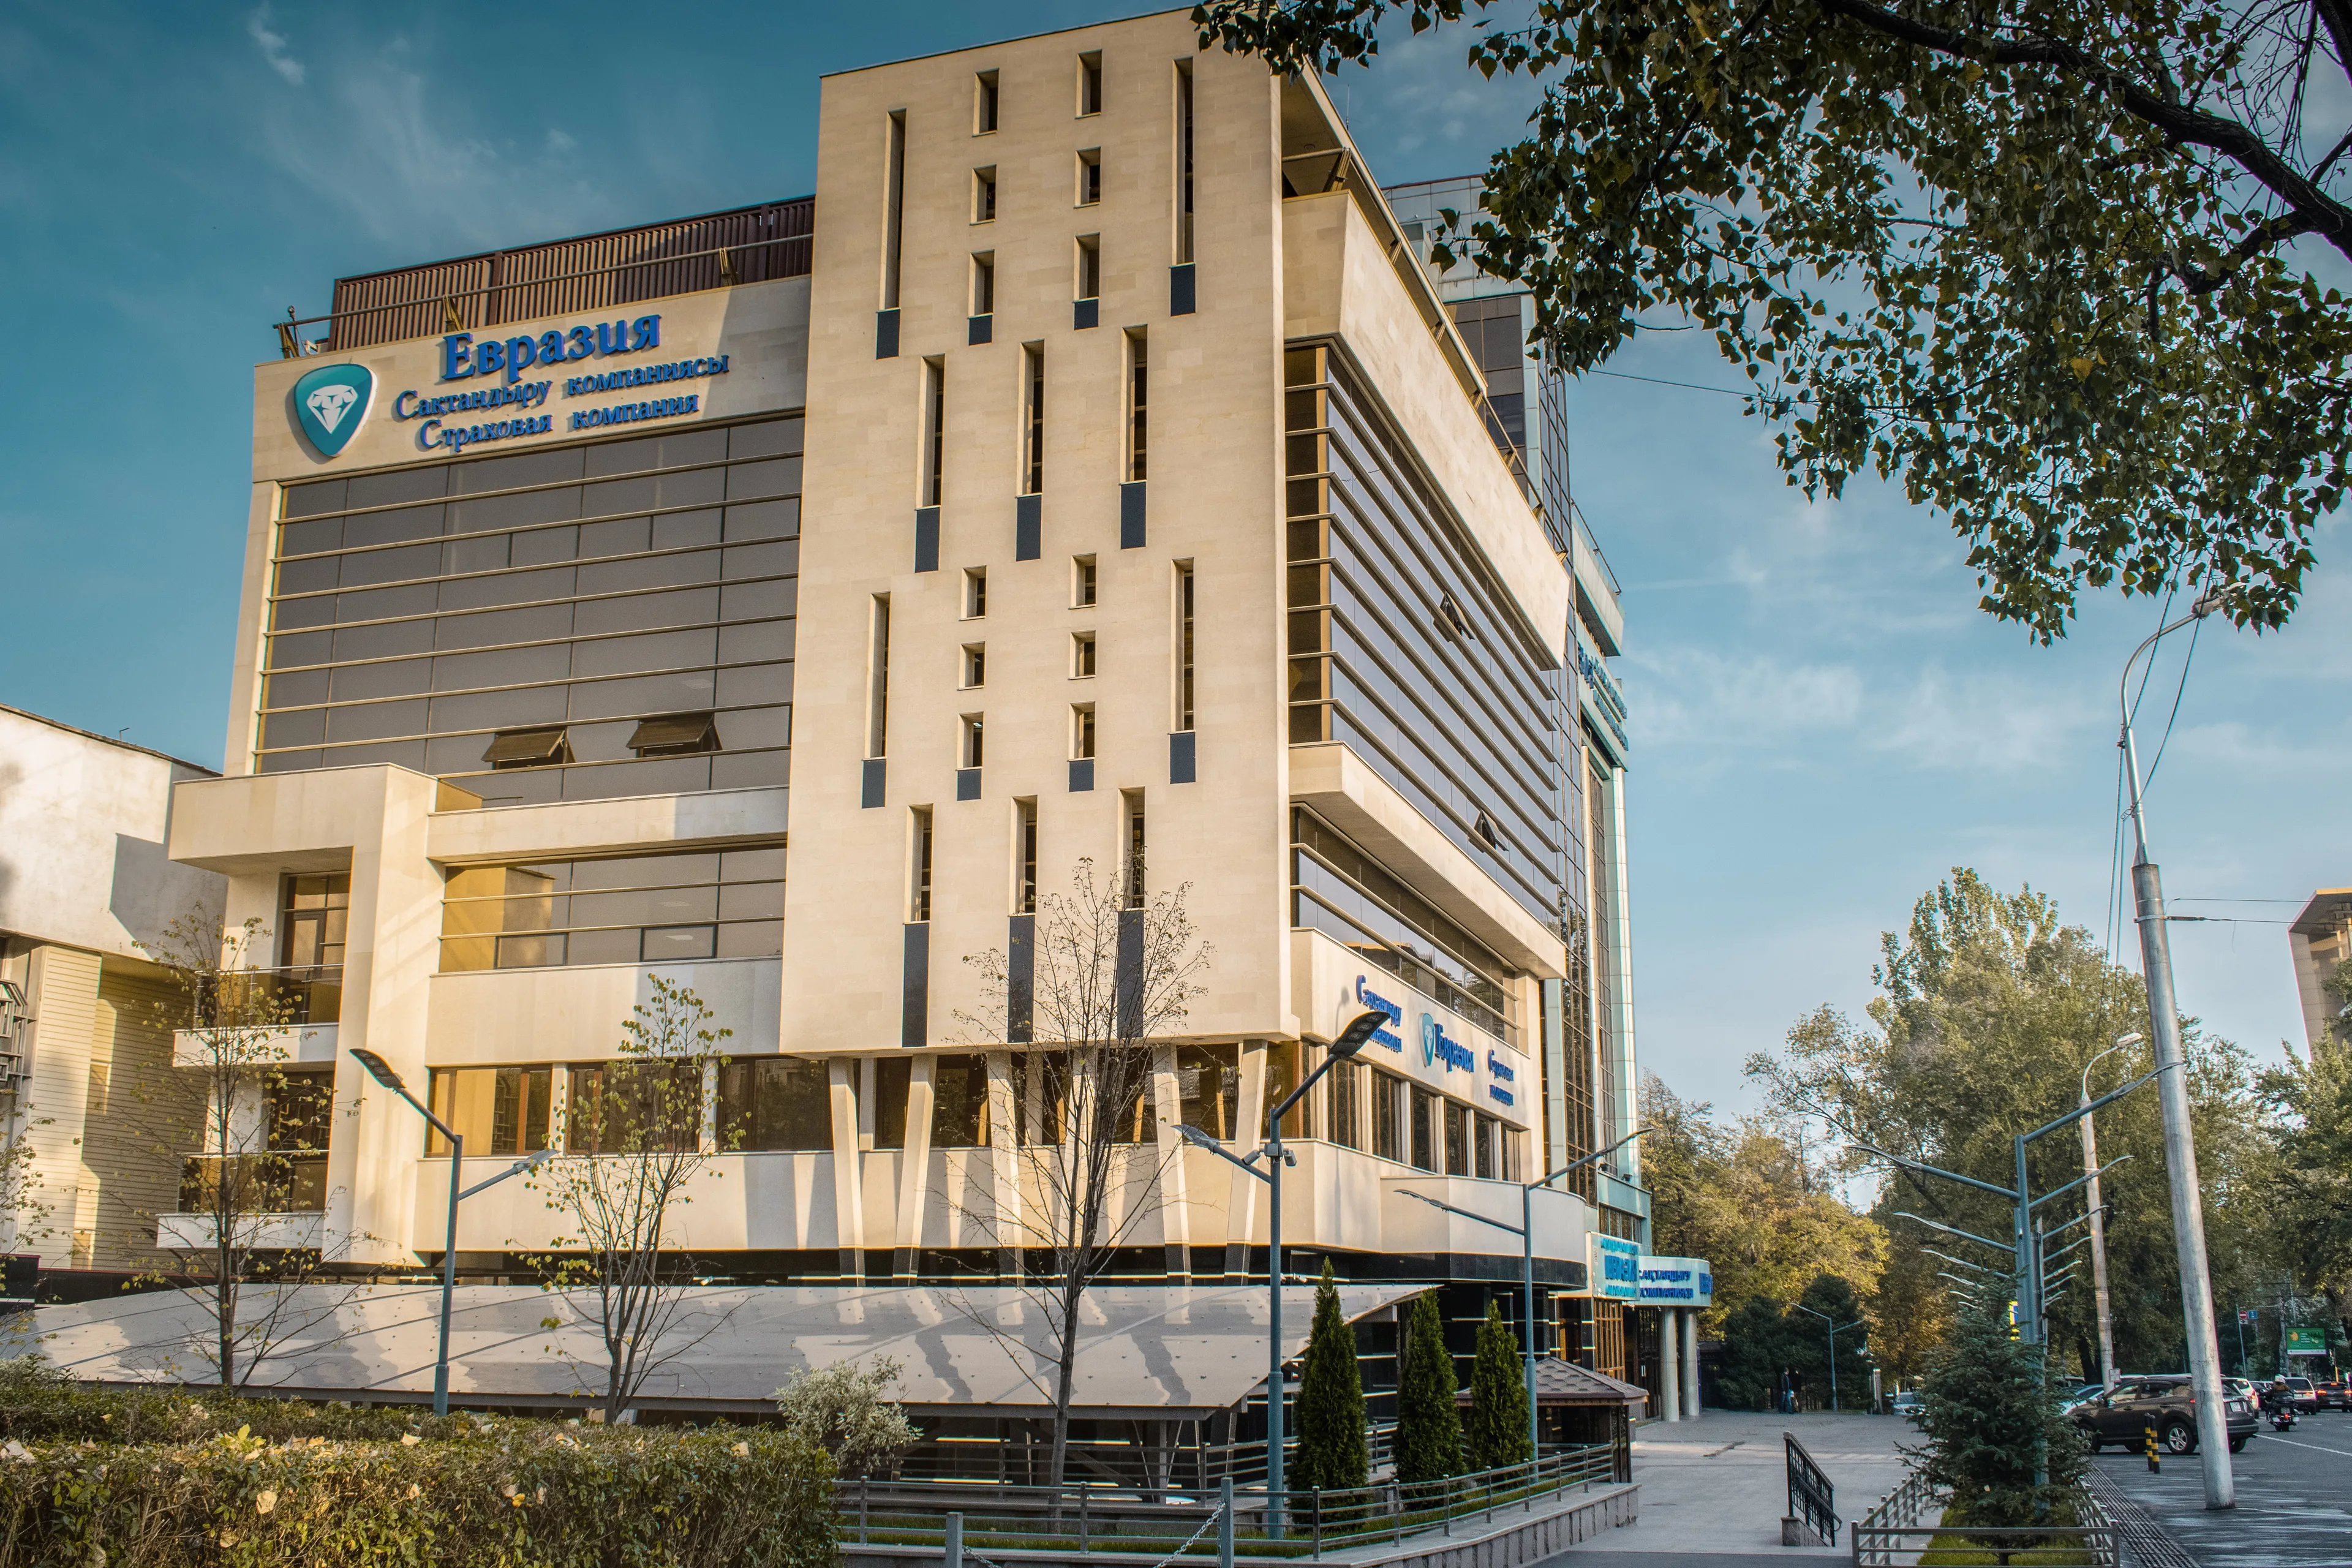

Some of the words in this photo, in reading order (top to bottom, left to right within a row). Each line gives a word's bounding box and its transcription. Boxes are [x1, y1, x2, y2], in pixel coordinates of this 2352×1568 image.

[442, 314, 662, 383] Евразия
[396, 380, 551, 419] Сақтандыру
[567, 354, 729, 396] компаниясы
[420, 414, 552, 453] Страховая
[573, 394, 699, 429] компания
[1434, 1023, 1474, 1073] Евразия
